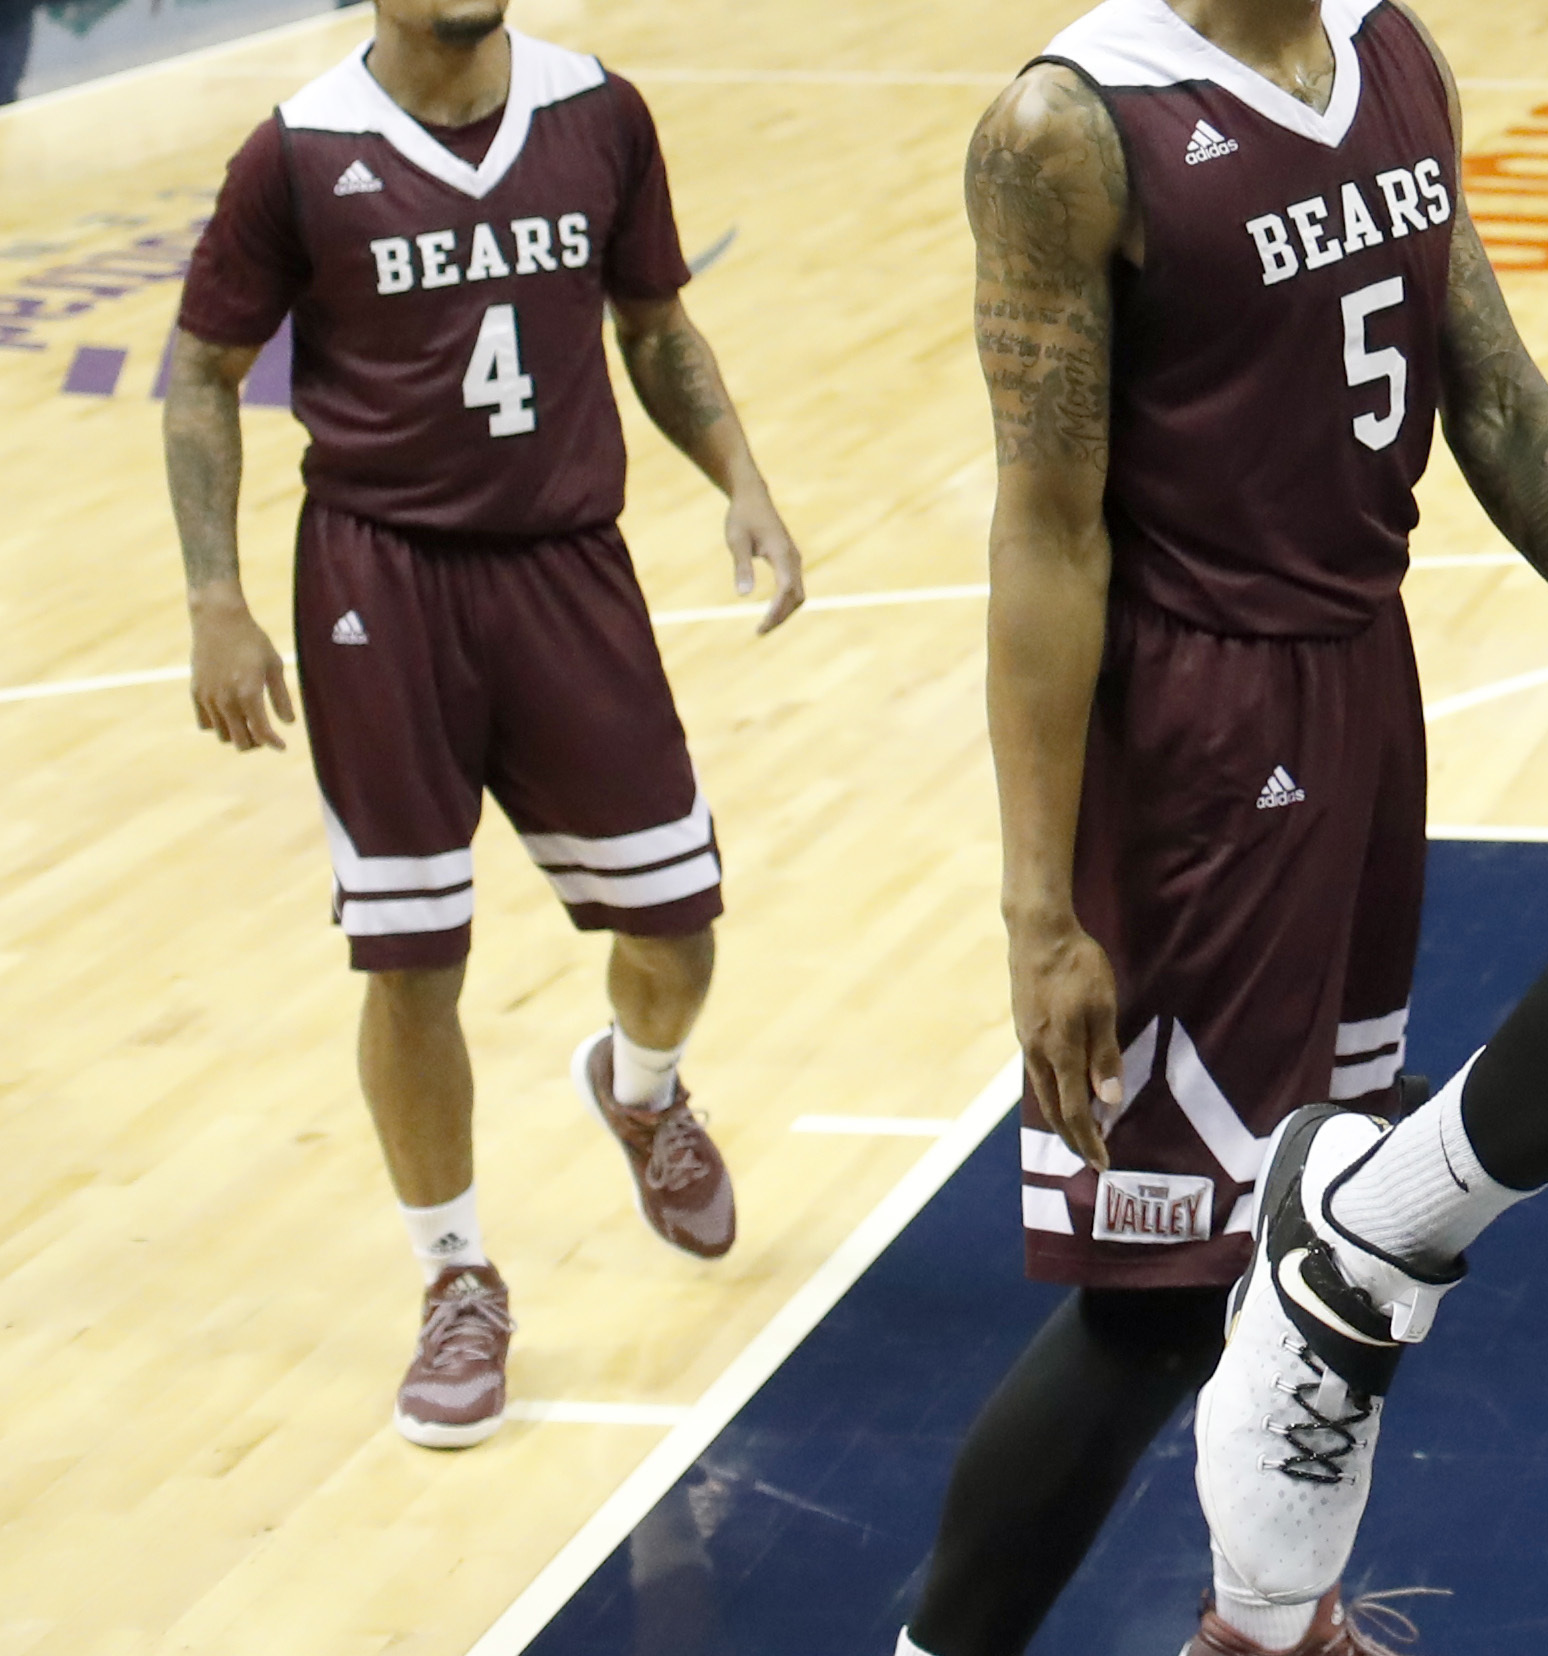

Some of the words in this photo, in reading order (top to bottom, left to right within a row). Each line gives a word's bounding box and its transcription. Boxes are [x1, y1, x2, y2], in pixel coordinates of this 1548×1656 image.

[1184, 138, 1239, 166] adidas
[369, 211, 592, 295] BEARS
[1245, 157, 1451, 286] BEARS
[462, 303, 537, 438] 4
[1340, 275, 1408, 452] 5
[1256, 788, 1307, 810] adidas
[1104, 1180, 1208, 1237] VALLEY
